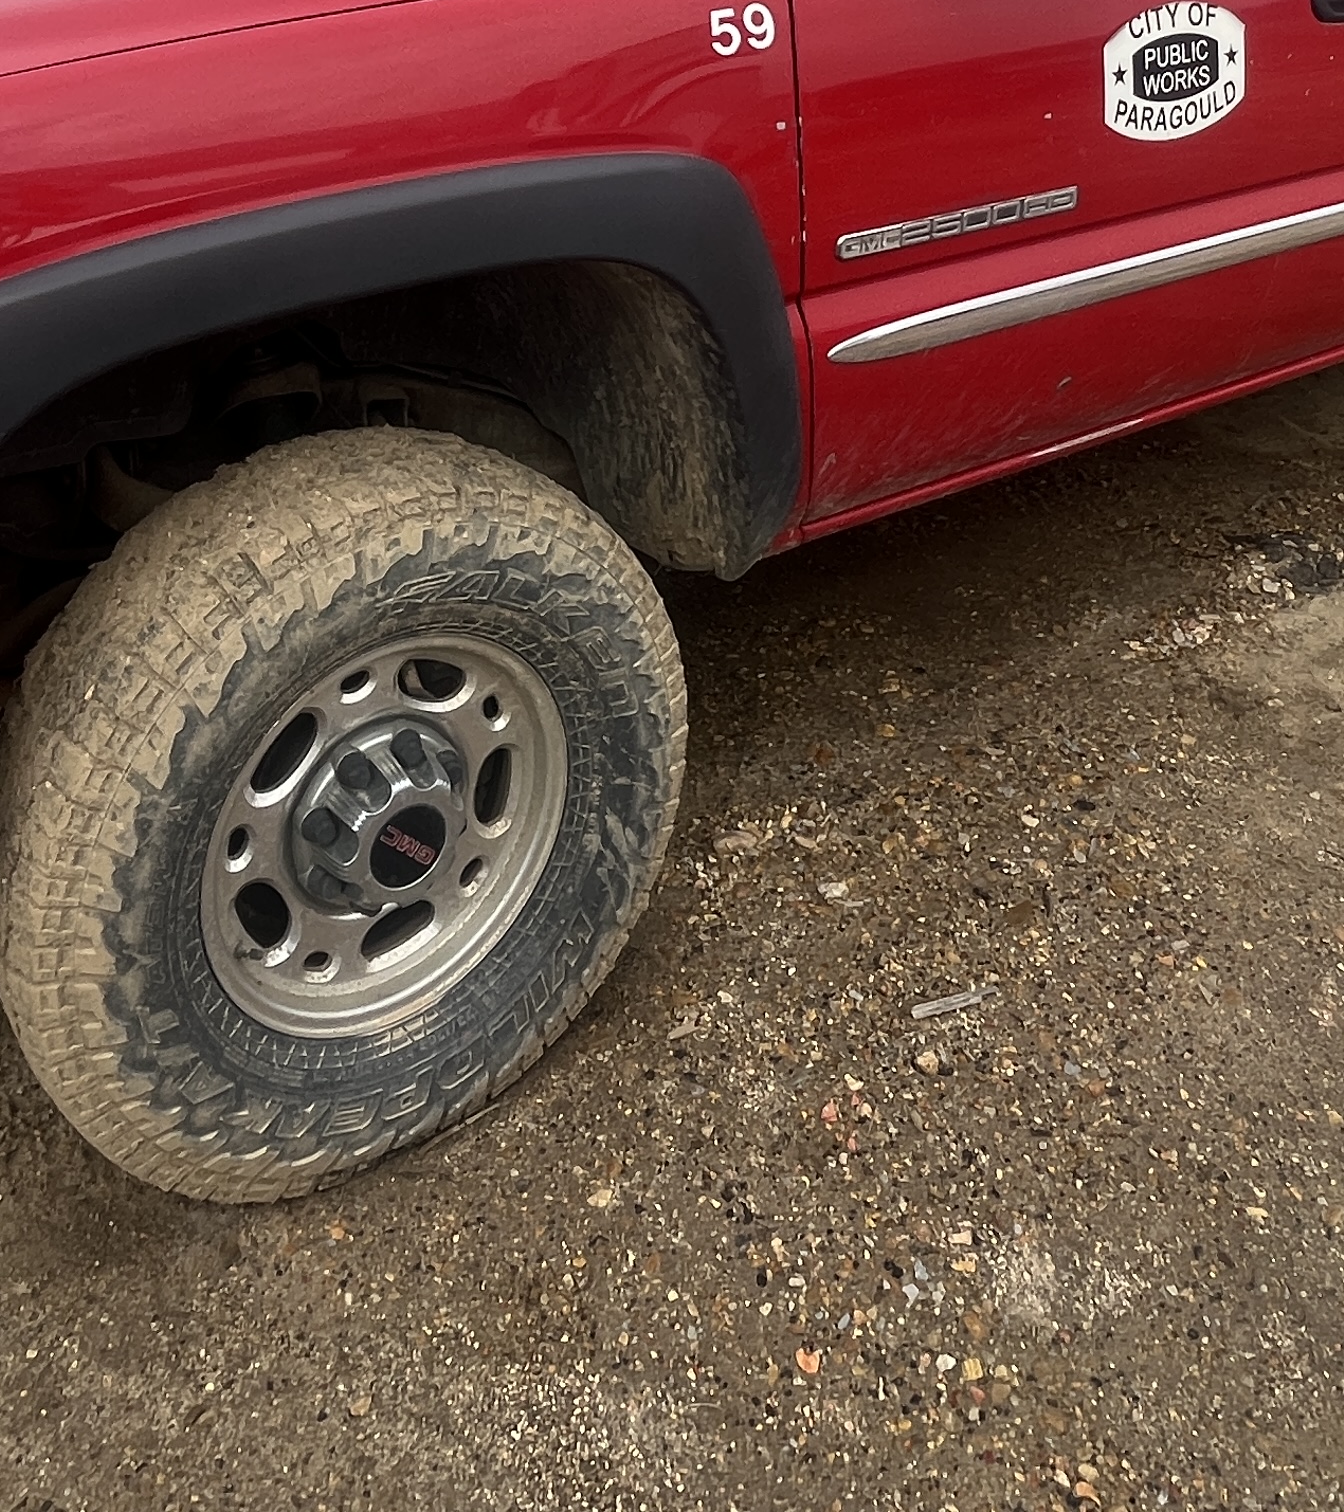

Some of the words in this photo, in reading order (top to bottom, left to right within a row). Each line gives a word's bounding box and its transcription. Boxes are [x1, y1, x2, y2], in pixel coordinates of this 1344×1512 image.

[709, 1, 776, 57] 59
[1128, 2, 1180, 39] CITY
[1187, 1, 1219, 27] OF
[1143, 39, 1209, 71] PUBLIC
[1143, 65, 1211, 97] WORKS
[1113, 80, 1236, 131] PARAGOULD
[379, 823, 437, 867] GMC
